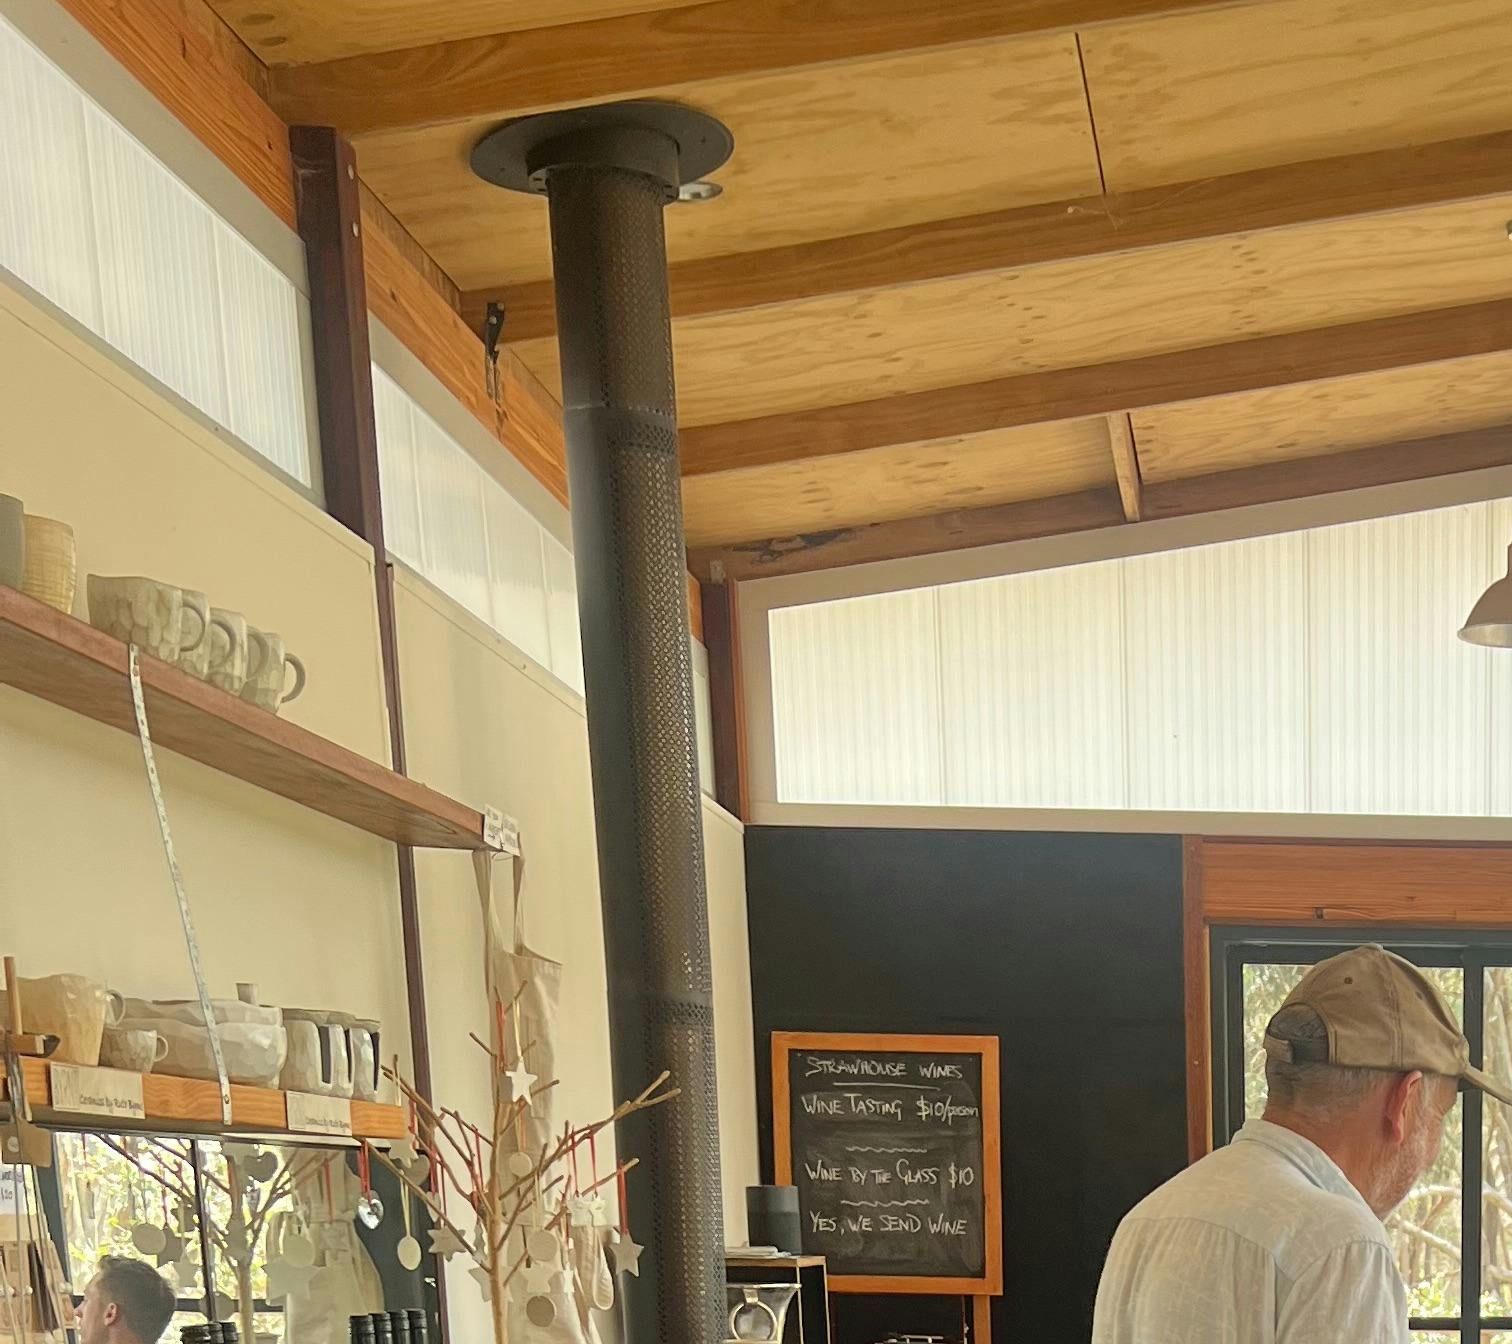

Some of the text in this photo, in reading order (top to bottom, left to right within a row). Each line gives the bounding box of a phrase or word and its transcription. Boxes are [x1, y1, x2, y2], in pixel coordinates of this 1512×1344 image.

[805, 1057, 963, 1079] STRAWHOUSE WINES
[801, 1096, 844, 1116] WINE
[805, 1158, 975, 1189] WINE BY THE GLASS $10
[809, 1211, 968, 1236] YES, WE SEND WINE
